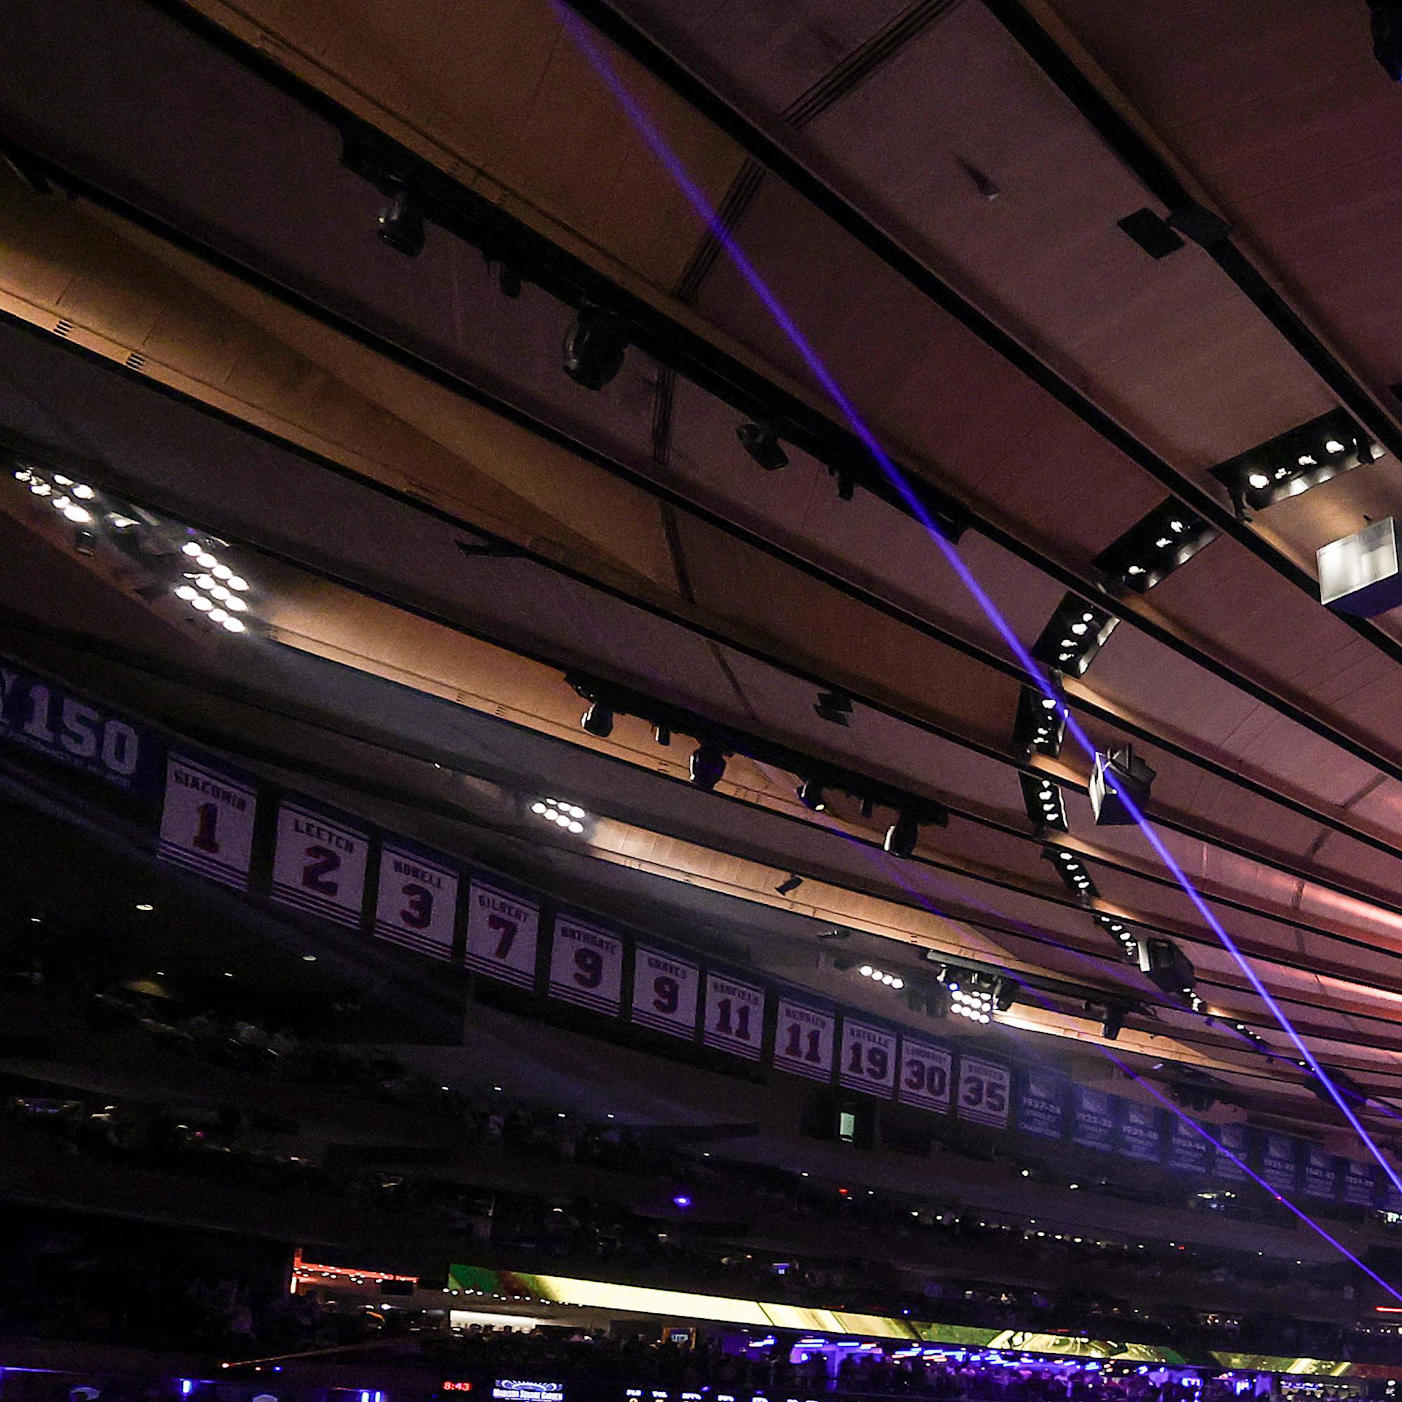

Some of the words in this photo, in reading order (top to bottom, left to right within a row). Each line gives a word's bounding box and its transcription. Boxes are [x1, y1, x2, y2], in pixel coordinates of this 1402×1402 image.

[24, 683, 139, 776] 150
[174, 770, 246, 812] GIACOMIN
[193, 802, 219, 853] 1
[294, 819, 355, 854] LEETCH
[302, 846, 340, 897] 2
[400, 884, 434, 929] 3
[488, 914, 518, 959] 7
[573, 948, 602, 989] 9
[653, 976, 679, 1014] 9
[716, 998, 750, 1041] 11
[785, 1022, 821, 1063] 11
[849, 1042, 888, 1080] 19
[904, 1058, 946, 1098] 30
[962, 1074, 1005, 1113] 35
[443, 1381, 471, 1391] 8:43
